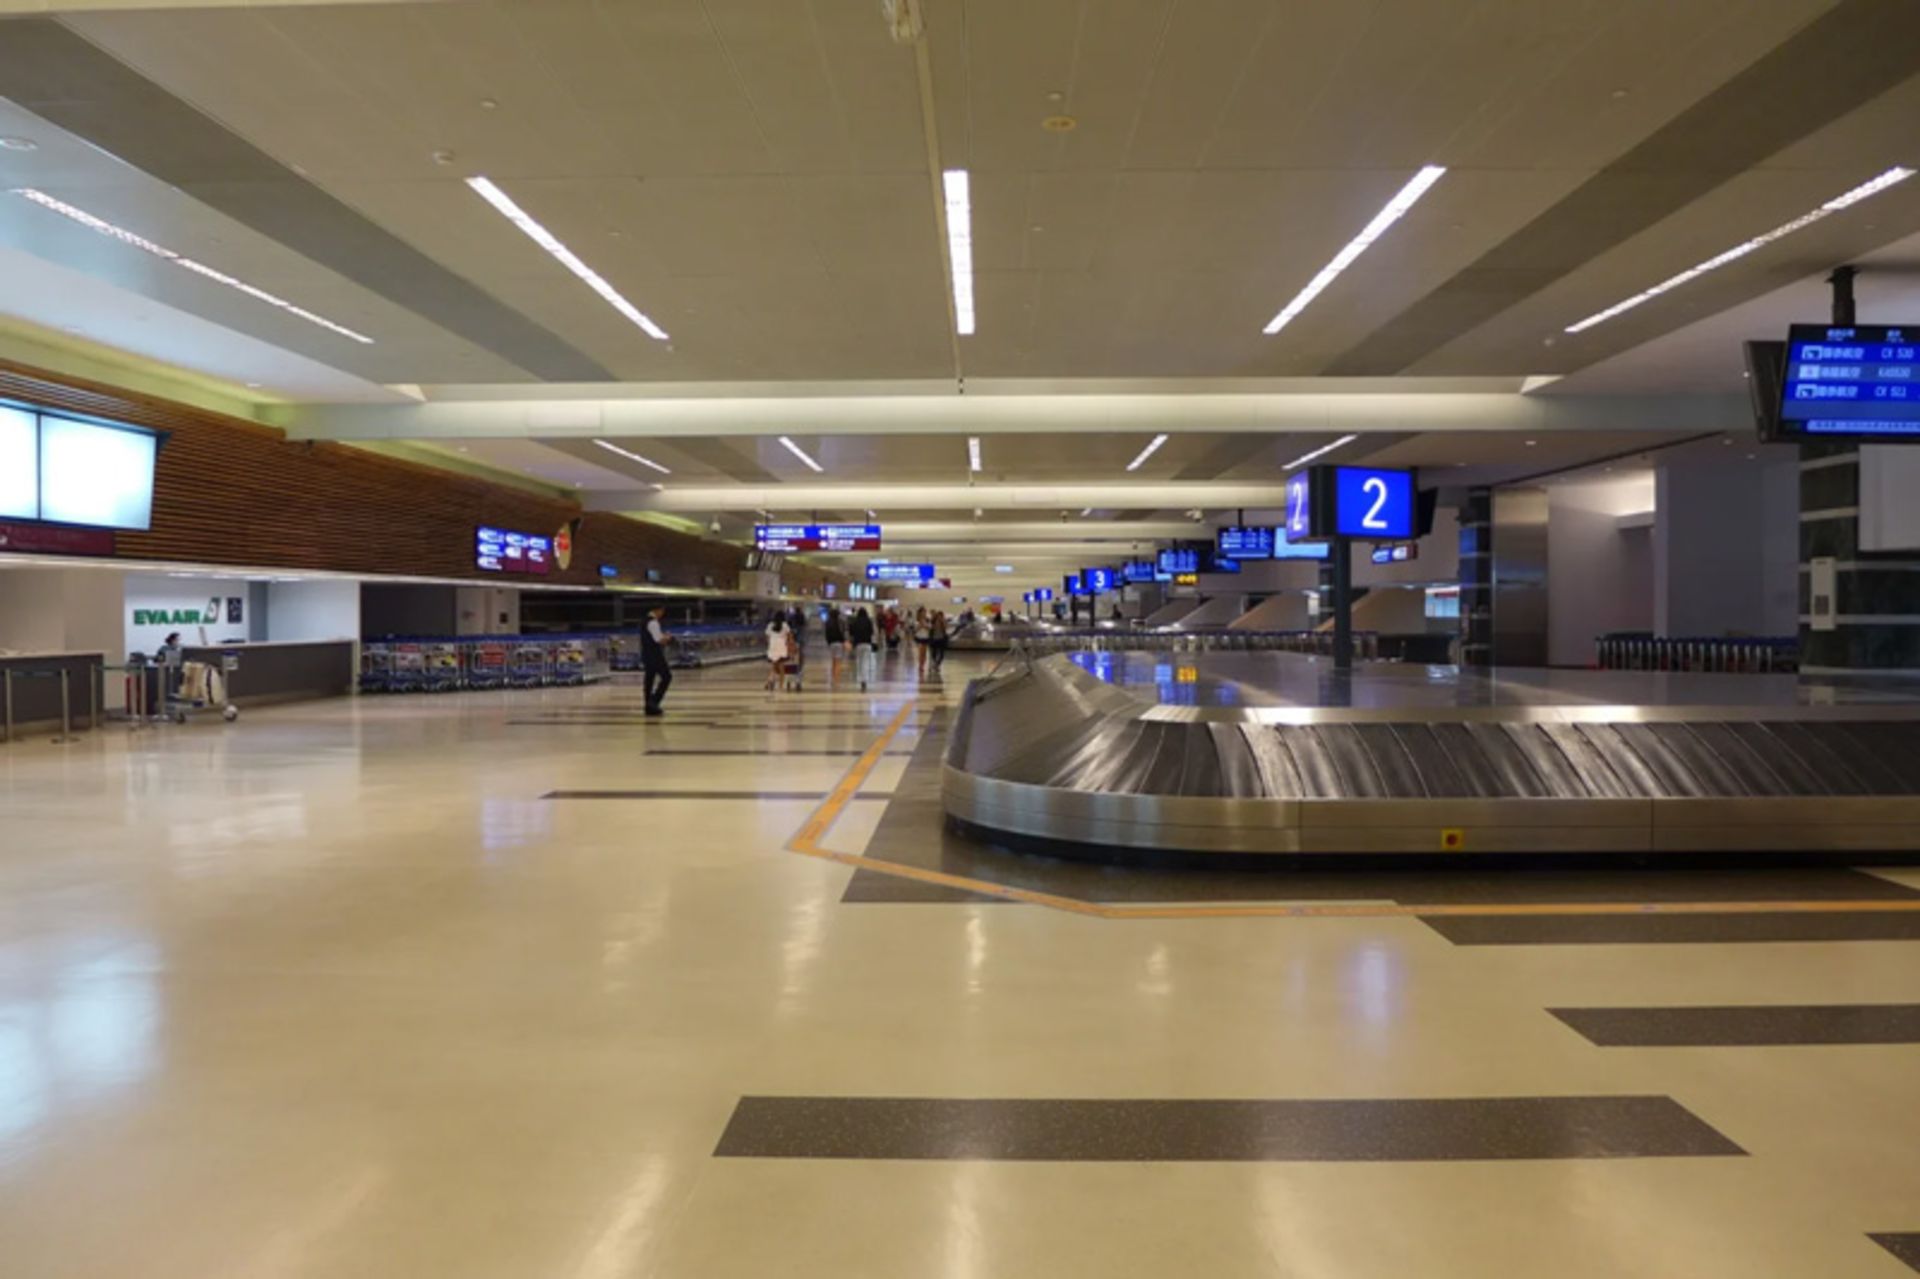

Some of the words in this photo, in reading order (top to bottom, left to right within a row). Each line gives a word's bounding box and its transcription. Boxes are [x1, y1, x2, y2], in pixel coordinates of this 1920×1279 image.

[1292, 481, 1303, 532] 2
[1362, 477, 1388, 529] 2
[1095, 570, 1105, 588] 3
